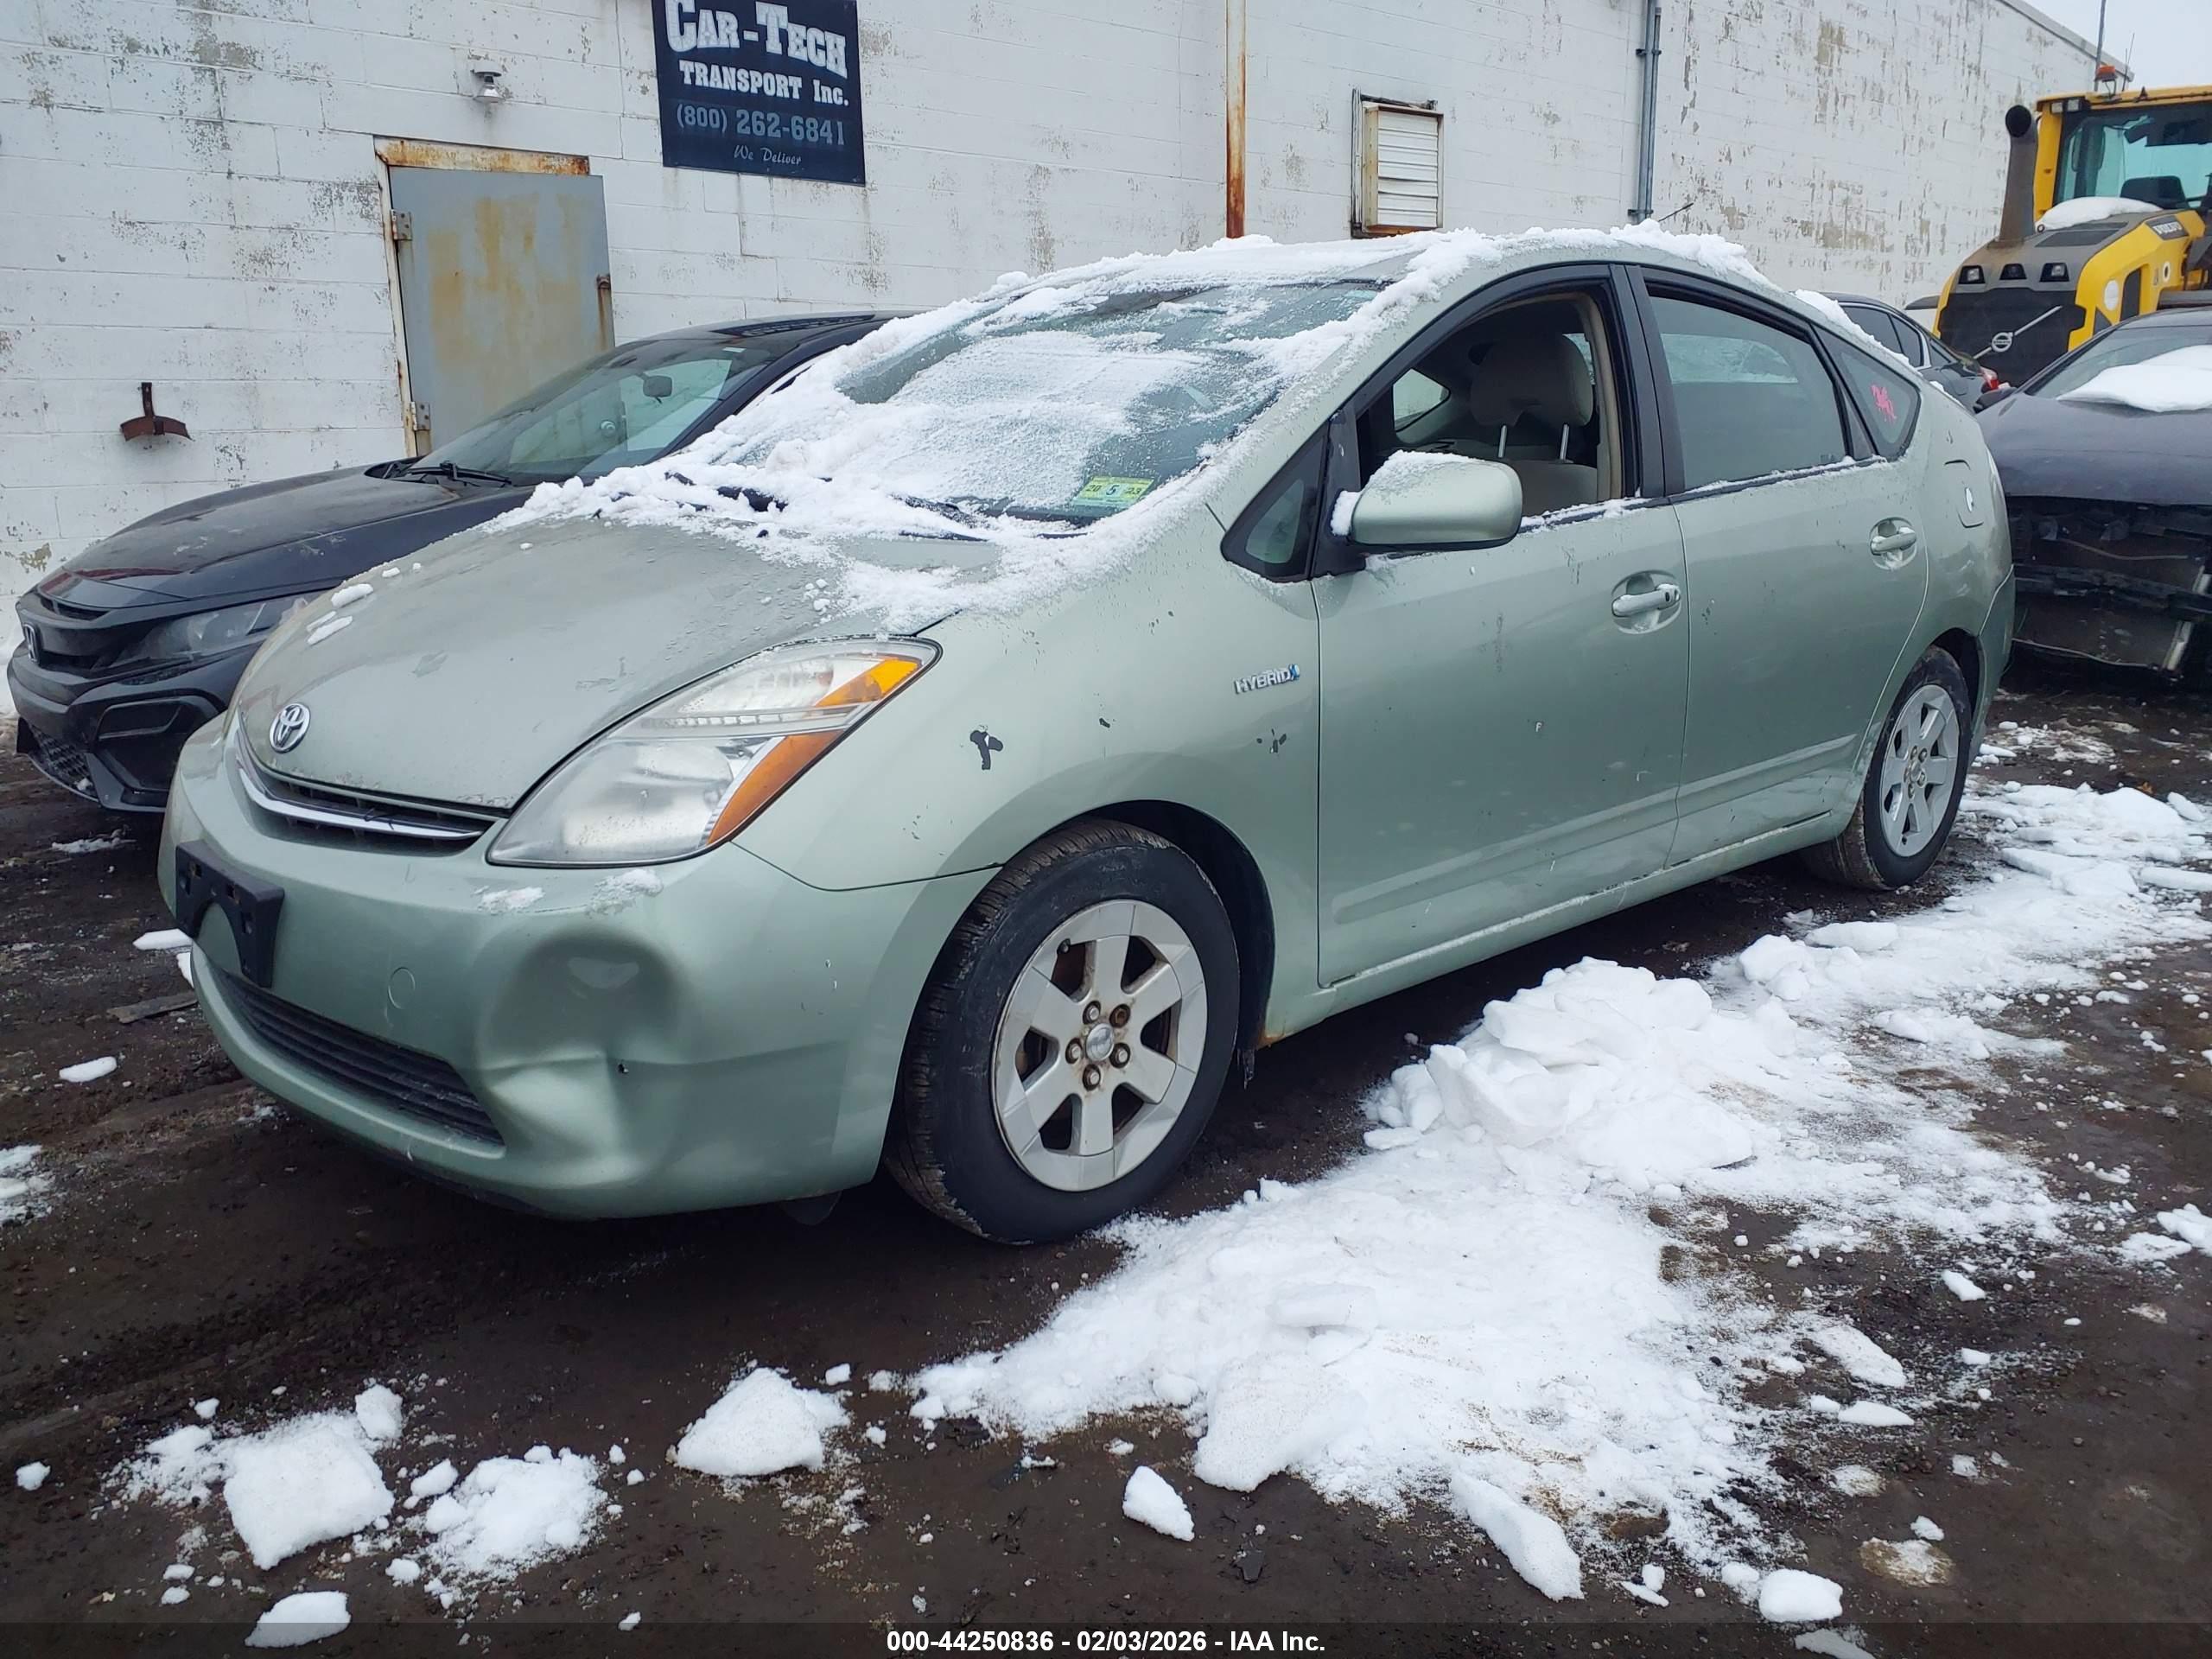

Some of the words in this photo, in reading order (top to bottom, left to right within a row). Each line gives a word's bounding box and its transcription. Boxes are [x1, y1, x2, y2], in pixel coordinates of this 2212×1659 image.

[679, 60, 802, 99] TRANSPORT
[813, 79, 849, 106] Inc.
[677, 104, 728, 133] (800)
[736, 109, 844, 145] 262-6841
[734, 144, 753, 161] We
[761, 148, 802, 166] Deliver
[1234, 668, 1291, 694] HYBRID
